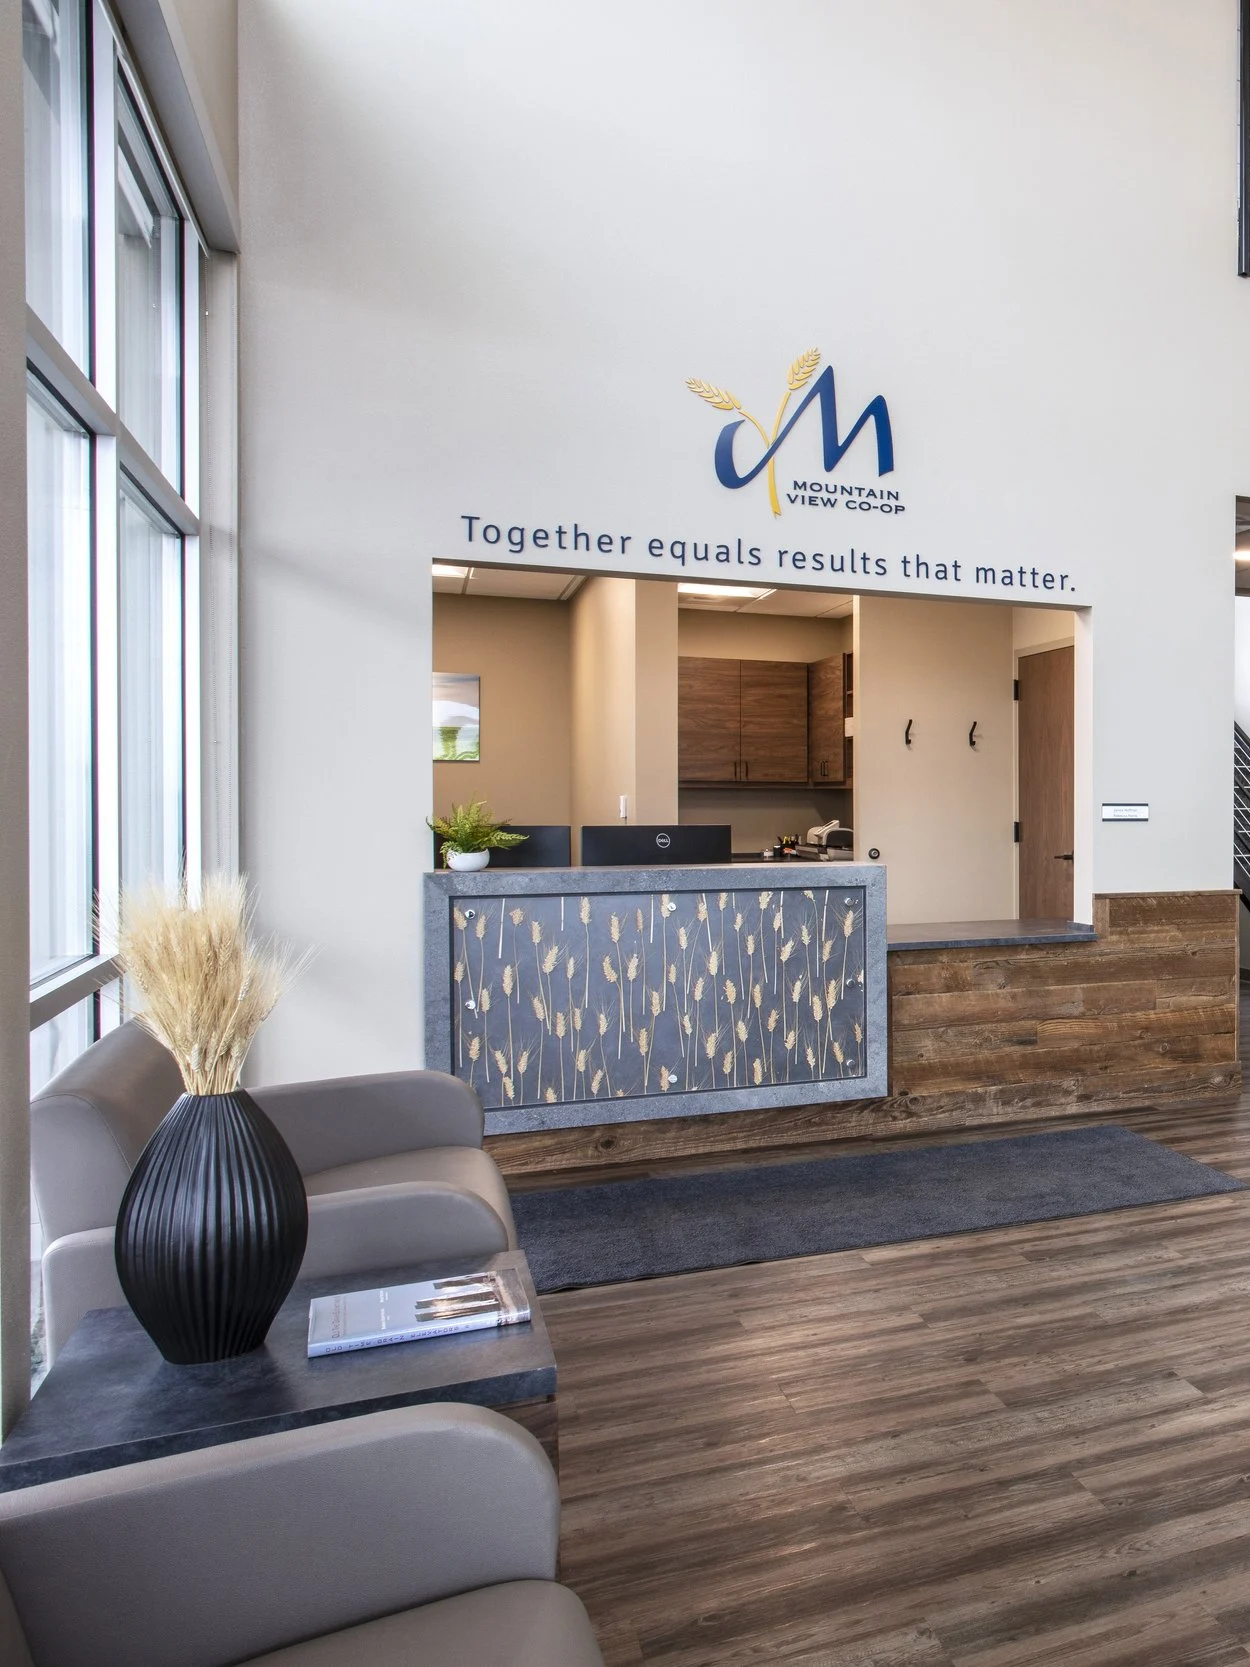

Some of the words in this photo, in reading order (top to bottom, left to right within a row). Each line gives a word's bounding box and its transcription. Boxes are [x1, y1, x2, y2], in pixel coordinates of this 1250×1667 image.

[793, 480, 900, 501] MOUNTAIN
[786, 493, 838, 508] VIEW
[845, 500, 906, 515] CO-OP
[461, 515, 632, 554] Together
[648, 538, 762, 566] equals
[778, 548, 888, 576] results
[901, 553, 962, 582] that
[975, 565, 1077, 592] matter.
